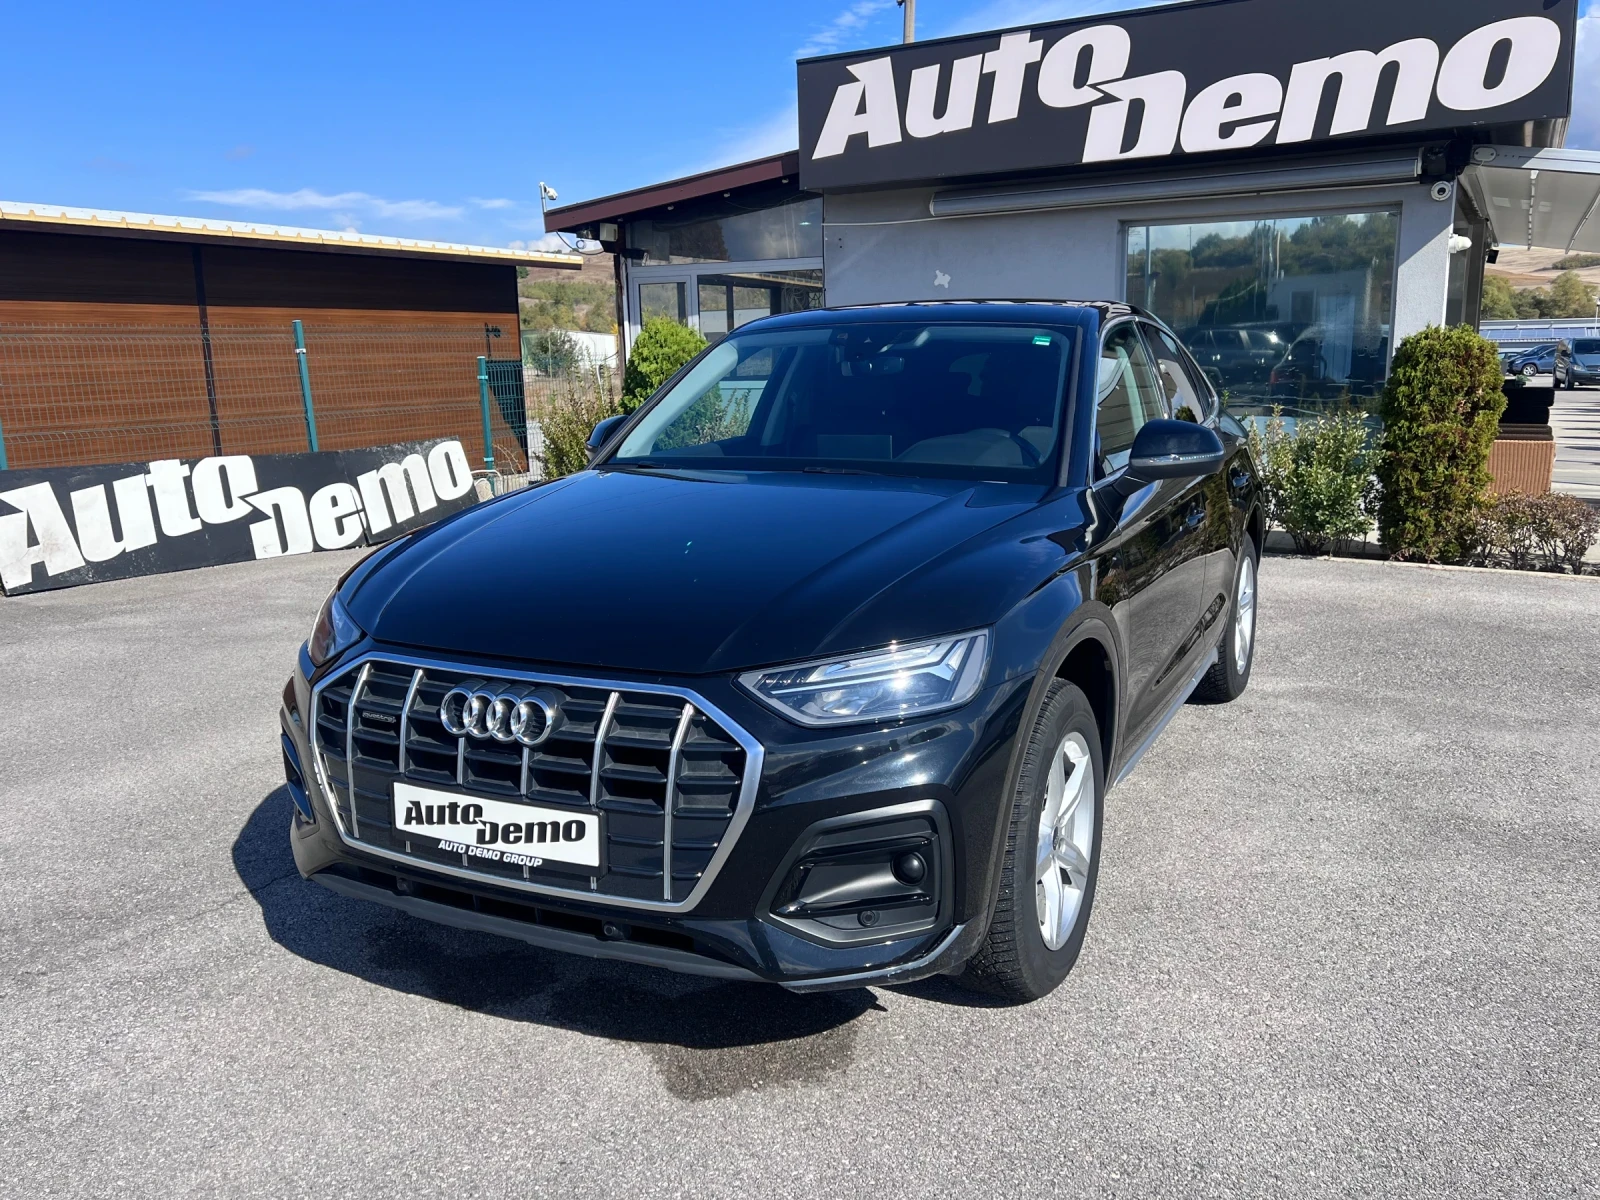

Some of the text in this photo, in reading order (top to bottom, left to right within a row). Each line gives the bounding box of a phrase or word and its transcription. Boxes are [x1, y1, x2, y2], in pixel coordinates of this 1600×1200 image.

[812, 15, 1561, 163] Auto Demo
[0, 440, 474, 590] Auto Demo
[403, 800, 586, 846] Auto Demo
[438, 840, 543, 868] AUTO DEMO GROUP
